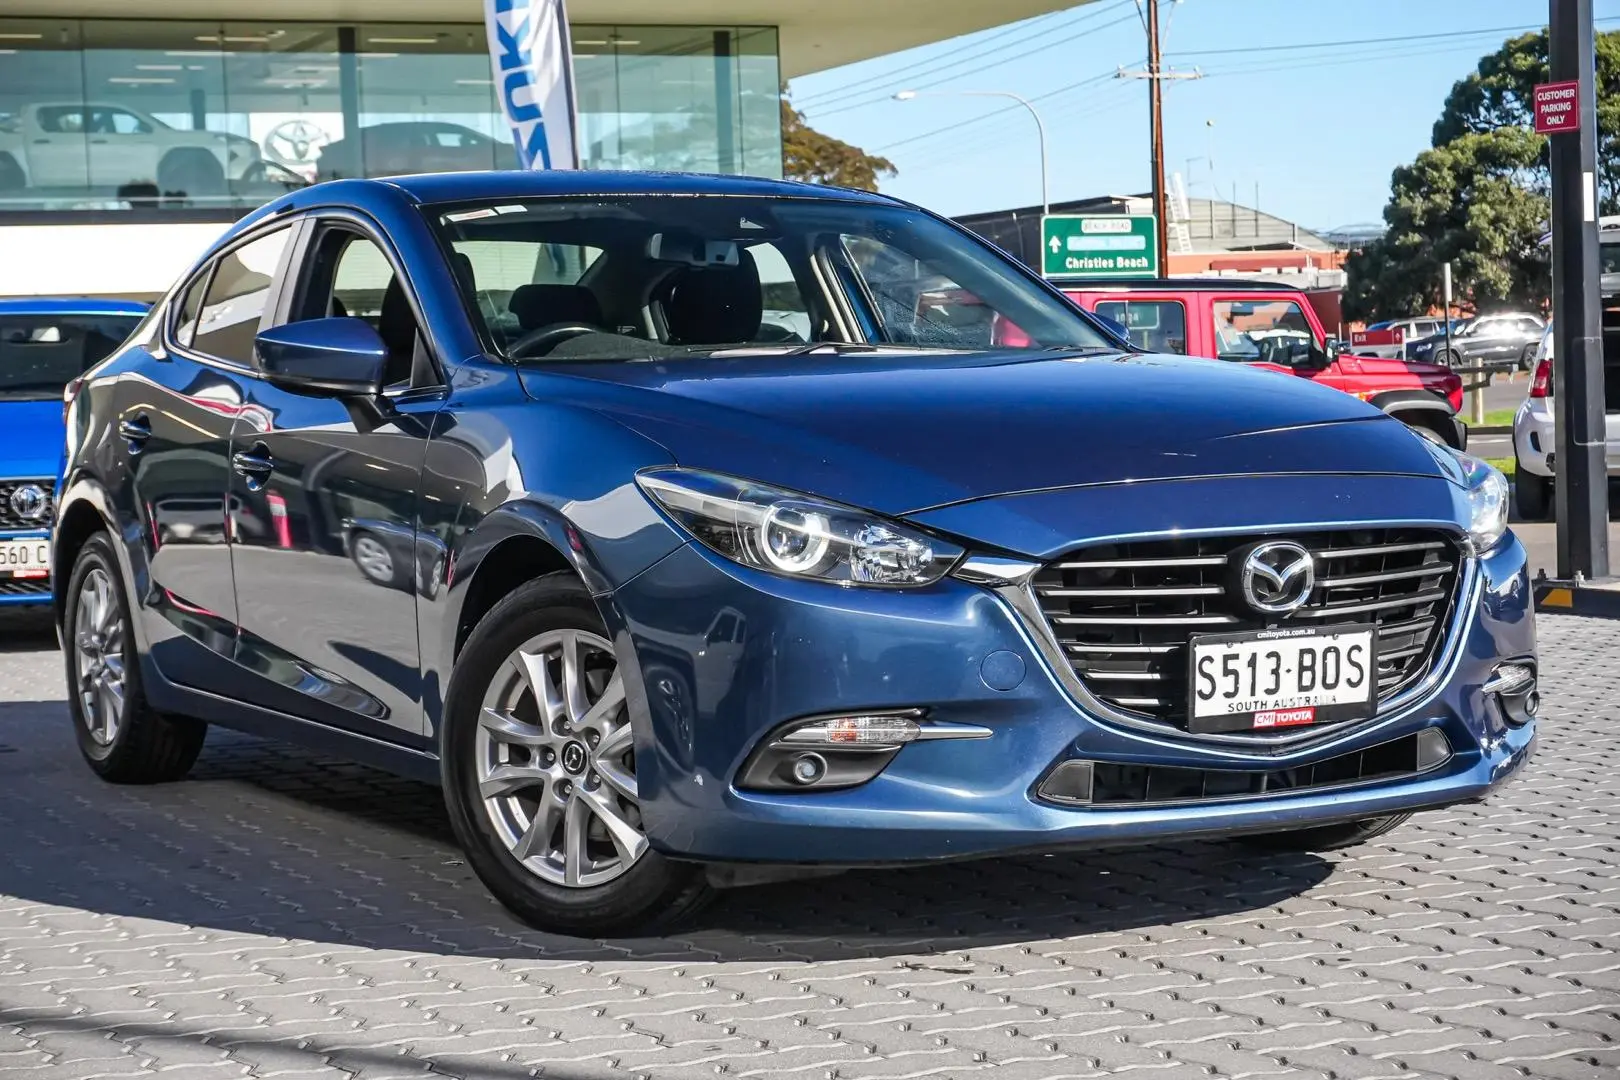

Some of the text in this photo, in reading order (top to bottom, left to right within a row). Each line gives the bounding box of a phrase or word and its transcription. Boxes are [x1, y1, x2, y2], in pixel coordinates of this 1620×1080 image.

[1537, 89, 1575, 101] CUSTOMER
[1540, 102, 1571, 113] PARKING
[1546, 115, 1565, 125] ONLY
[1065, 255, 1149, 269] Christies Beach
[1354, 334, 1367, 343] Exit
[1256, 628, 1316, 639] cmitoyota.com.au
[1227, 700, 1268, 713] SOUTH
[1255, 710, 1313, 725] CMI TOYOTA
